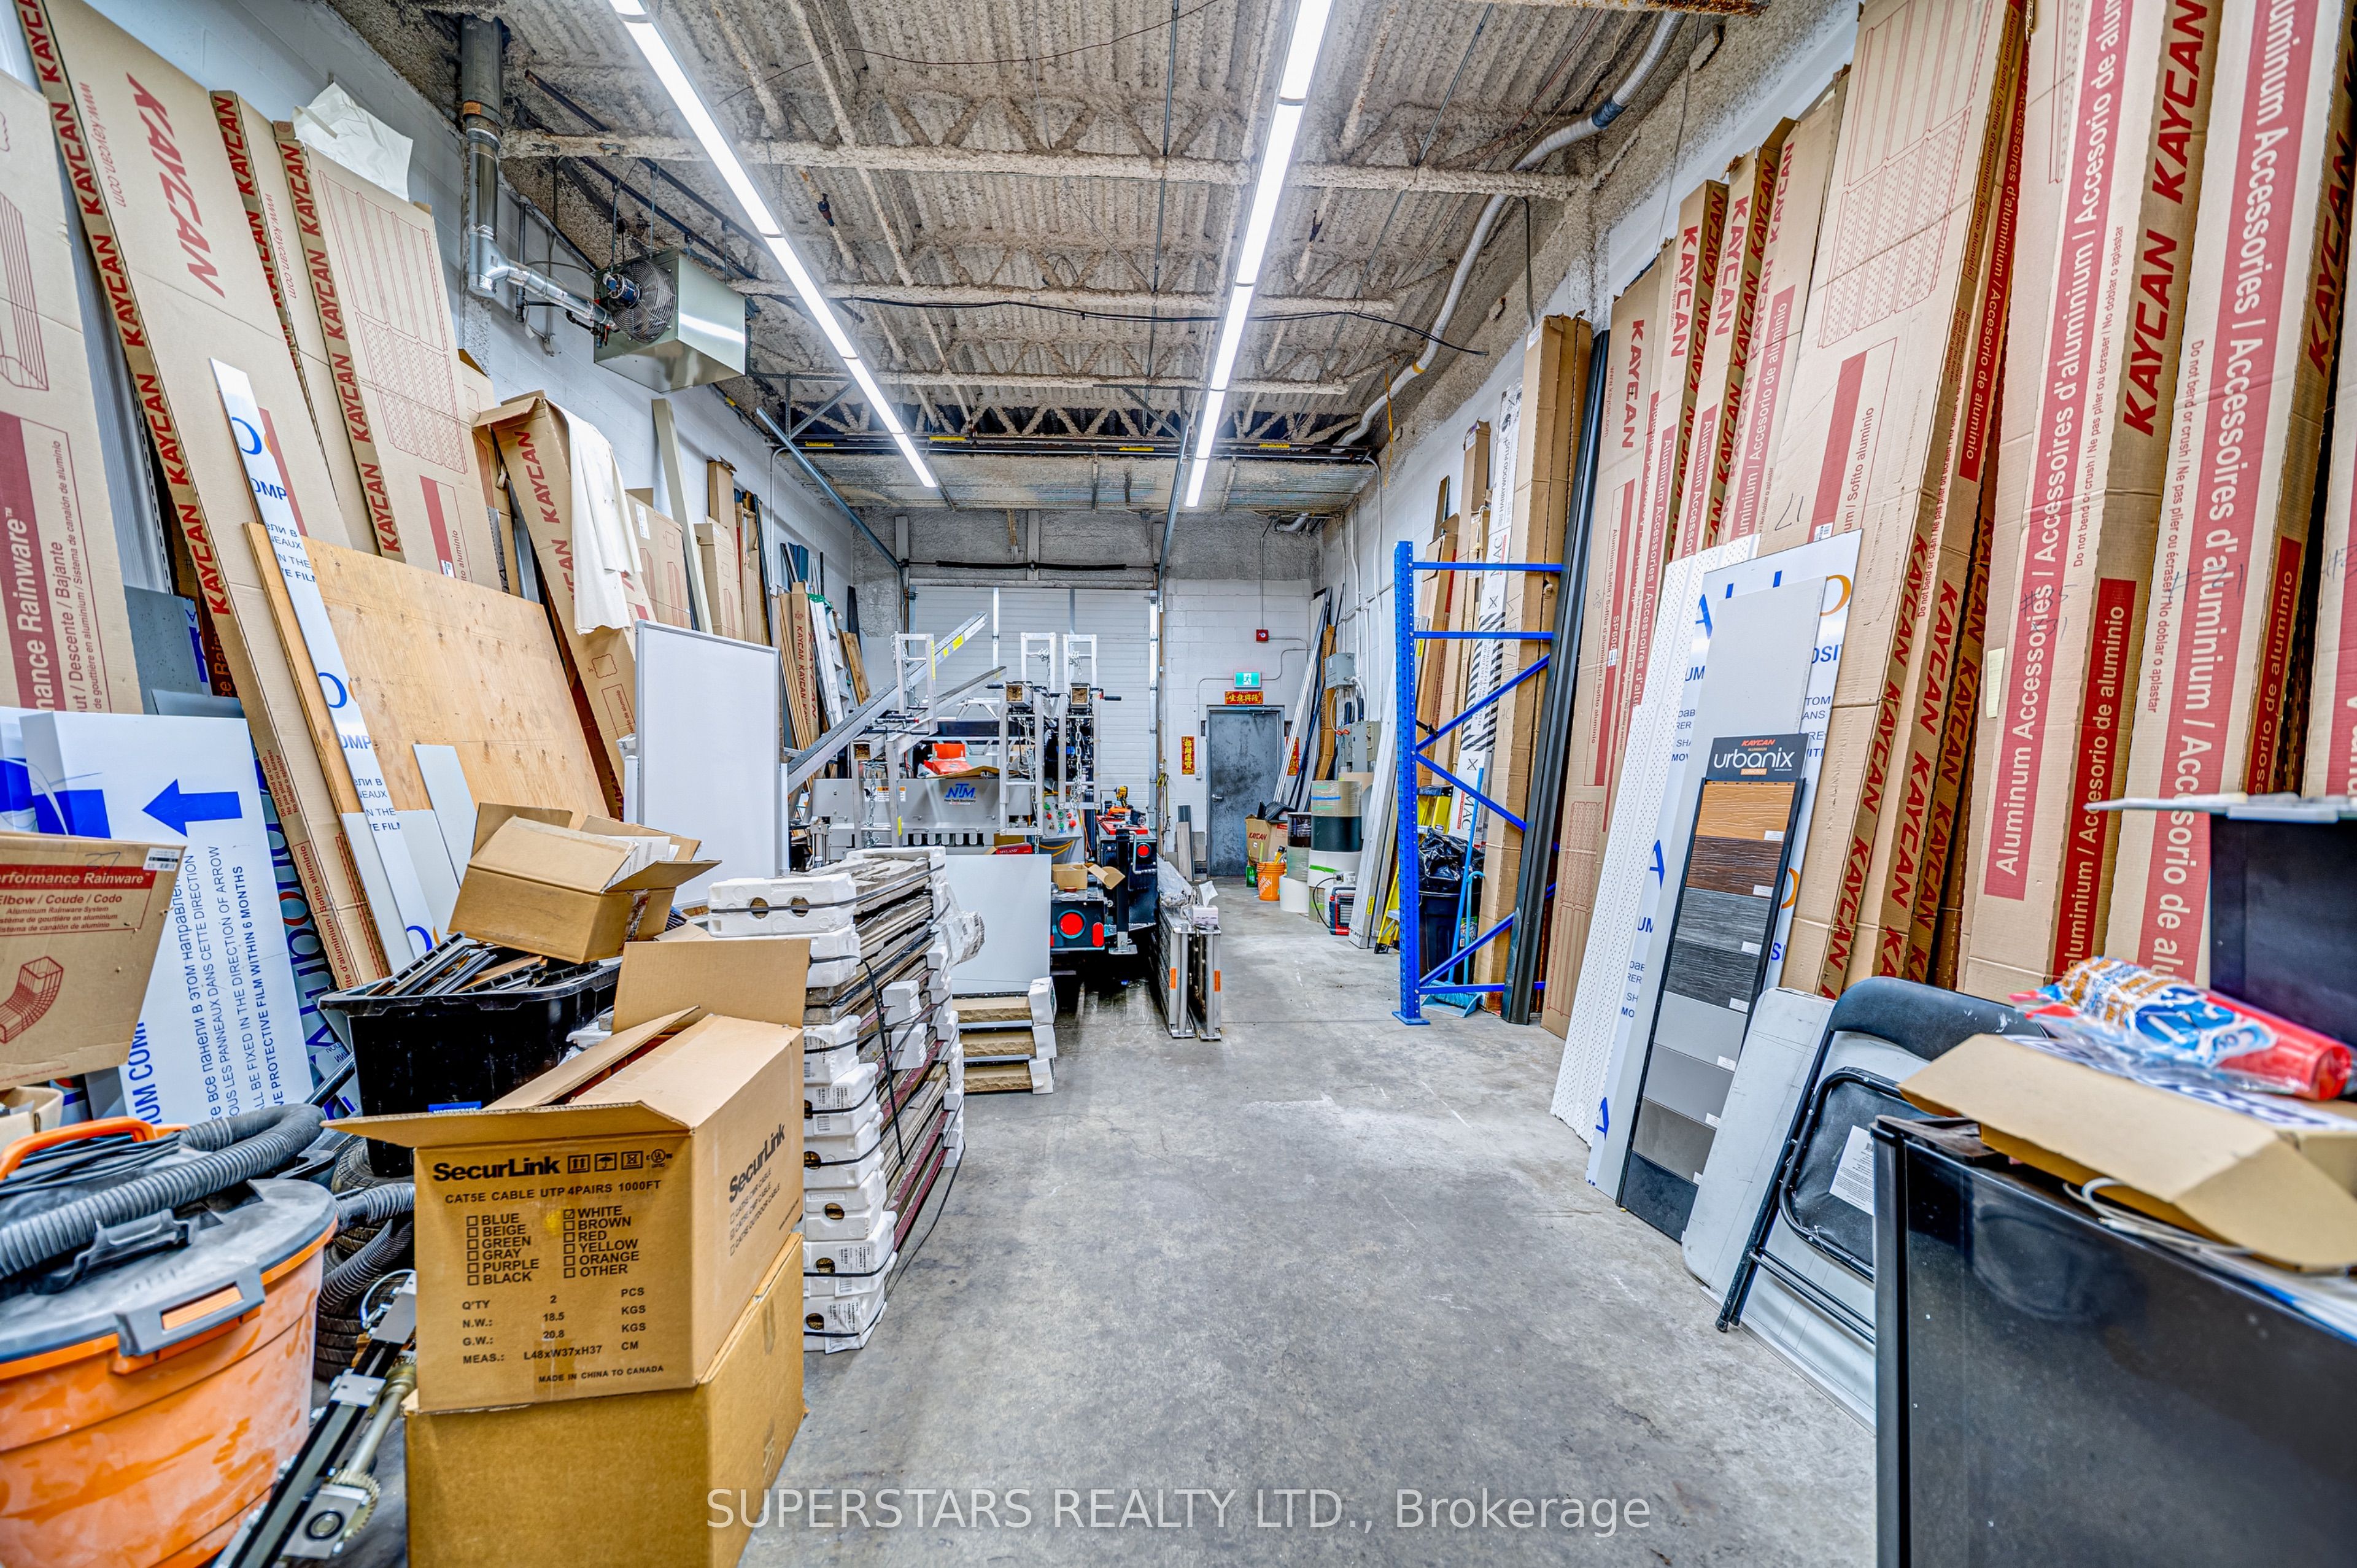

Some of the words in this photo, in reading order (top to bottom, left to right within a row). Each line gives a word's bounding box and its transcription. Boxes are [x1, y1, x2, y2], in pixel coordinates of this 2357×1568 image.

[2095, 52, 2116, 90] de
[51, 102, 104, 215] KAYCAN
[79, 82, 126, 207] www.kaycan.com
[214, 96, 255, 196] KAYCAN
[2074, 90, 2114, 225] Accesorio
[126, 72, 225, 298] KAYCAN
[281, 143, 321, 237] KAYCAN
[1770, 142, 1795, 244] KAYCAN
[1750, 158, 1777, 263] KAYCAN
[1994, 185, 2016, 277] d'aluminium
[2233, 126, 2289, 316] Accessories
[265, 193, 296, 299] www.kaycan.com
[1703, 191, 1724, 290] KAYCAN
[2111, 225, 2124, 272] aplastar
[2308, 129, 2353, 378] KAYCAN
[1715, 195, 1749, 336] KAYCAN
[92, 234, 145, 347] KAYCAN
[308, 249, 346, 341] KAYCAN
[1670, 225, 1698, 358] KAYCAN
[1751, 259, 1774, 361] KAYCAN
[2105, 285, 2116, 314] doblar
[1734, 271, 1760, 371] KAYCAN
[1768, 302, 1787, 363] aluminio
[1980, 288, 2001, 366] Accesorio
[2054, 240, 2094, 401] d'aluminium
[2103, 315, 2112, 330] No
[2123, 228, 2178, 438] KAYCAN
[1689, 298, 1711, 394] KAYCAN
[2098, 336, 2110, 373] écraser
[2189, 340, 2204, 359] Do
[1622, 319, 1644, 448] KAYCAN
[1762, 367, 1776, 385] de
[1977, 370, 1988, 388] de
[2097, 374, 2105, 388] ou
[2188, 361, 2200, 381] not
[331, 353, 371, 443] KAYCAN
[2094, 391, 2104, 414] plier
[2184, 411, 2193, 425] or
[2185, 382, 2198, 408] bend
[136, 374, 190, 485] KAYCAN
[1717, 382, 1742, 485] KAYCAN
[1730, 377, 1754, 477] KAYCAN
[1749, 388, 1773, 461] Accesorio
[1966, 391, 1984, 460] aluminio
[2089, 435, 2099, 451] Ne
[2091, 415, 2102, 434] pas
[2180, 427, 2192, 459] crush
[2208, 338, 2263, 521] Accessoires
[514, 431, 560, 523] KAYCAN
[1657, 439, 1672, 503] Aluminum
[1695, 420, 1713, 488] Aluminum
[1848, 463, 1864, 501] Sofito
[1856, 407, 1875, 460] aluminio
[2084, 458, 2096, 489] crush
[2177, 465, 2186, 484] Ne
[2034, 403, 2075, 563] Accessoires
[2173, 485, 2184, 505] pas
[361, 463, 401, 552] KAYCAN
[2078, 505, 2089, 530] bend
[2171, 506, 2182, 531] plier
[178, 504, 231, 615] KAYCAN
[1648, 506, 1664, 583] Accessories
[2073, 550, 2083, 568] Do
[2075, 532, 2085, 549] not
[2170, 534, 2178, 548] ou
[50, 542, 71, 598] Bajante
[1893, 532, 1928, 668] KAYCAN
[2161, 601, 2172, 619] No
[2185, 533, 2237, 711] d'aluminium
[2271, 570, 2292, 675] aluminio
[61, 612, 83, 682] Descente
[1637, 593, 1655, 670] Accessoires
[2097, 606, 2125, 698] aluminio
[2157, 620, 2171, 655] doblar
[1921, 579, 1958, 736] KAYCAN
[2012, 584, 2052, 740] Accessories
[2148, 668, 2161, 714] aplastar
[2266, 685, 2278, 716] de
[1941, 655, 1977, 786] KAYCAN
[2093, 704, 2113, 730] de
[1713, 747, 1795, 768] urbanix
[1863, 679, 1901, 815] KAYCAN
[945, 783, 976, 798] NTM
[1995, 747, 2032, 876] Aluminum
[1891, 750, 1931, 910] KAYCAN
[184, 855, 205, 919] DIRECTION
[208, 846, 226, 893] ARROW
[1916, 800, 1952, 930] KAYCAN
[45, 895, 83, 905] Coude
[93, 894, 122, 903] Codo
[217, 897, 230, 913] OF
[233, 866, 251, 919] MONTHS
[1828, 835, 1869, 971] KAYCAN
[2157, 893, 2191, 929] de
[196, 922, 212, 960] CETTE
[221, 917, 244, 986] DIRECTION
[244, 931, 261, 976] WITHIN
[203, 963, 219, 997] DANS
[234, 989, 247, 1014] THE
[252, 978, 266, 1007] FILM
[210, 998, 230, 1063] PANNEAUX
[239, 1017, 250, 1030] IN
[242, 1032, 258, 1070] FIXED
[258, 1010, 281, 1089] PROTECTIVE
[222, 1064, 235, 1088] LES
[249, 1072, 261, 1091] BE
[433, 1157, 560, 1181] SecurLink
[729, 1123, 786, 1203] SecurLink
[445, 1193, 486, 1203] CAT5E
[491, 1189, 535, 1201] CABLE
[540, 1188, 565, 1198] UTP
[568, 1184, 613, 1195] 4PAIRS
[618, 1180, 662, 1192] 1000FT
[578, 1205, 623, 1219] WHITE
[482, 1213, 520, 1226] BLUE
[482, 1236, 531, 1249] GREEN
[483, 1224, 527, 1237] BEIGE
[578, 1216, 632, 1230] BROWN
[579, 1230, 607, 1242] RED
[482, 1248, 522, 1261] GRAY
[482, 1259, 540, 1272] PURPLE
[579, 1239, 639, 1253] YELLOW
[579, 1251, 640, 1266] ORANGE
[483, 1272, 532, 1285] BLACK
[579, 1264, 629, 1278] OTHER
[543, 1312, 565, 1321] 18.5
[621, 1305, 646, 1315] KGS
[550, 1295, 557, 1303] 2
[621, 1287, 645, 1297] PCS
[543, 1329, 565, 1339] 20.8
[621, 1323, 646, 1333] KGS
[621, 1341, 639, 1350] CM
[538, 1374, 564, 1383] MADE
[581, 1370, 609, 1379] CHINA
[626, 1365, 664, 1375] CANADA
